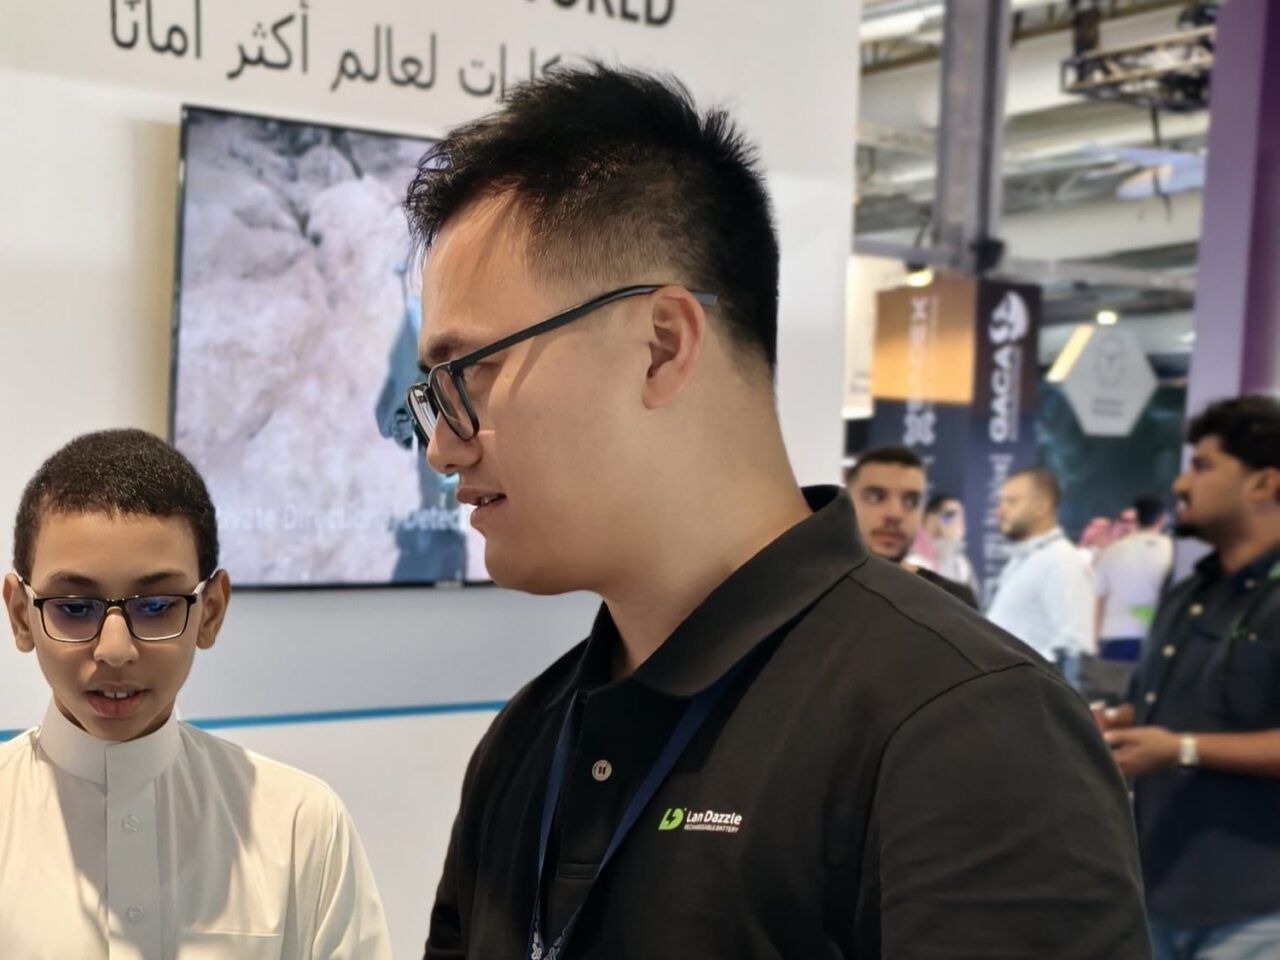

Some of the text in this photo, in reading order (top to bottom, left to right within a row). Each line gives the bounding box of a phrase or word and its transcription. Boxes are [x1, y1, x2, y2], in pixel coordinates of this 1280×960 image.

[227, 0, 310, 80] أكثر
[331, 24, 437, 92] لعالم
[686, 810, 742, 825] Lan Dazzle
